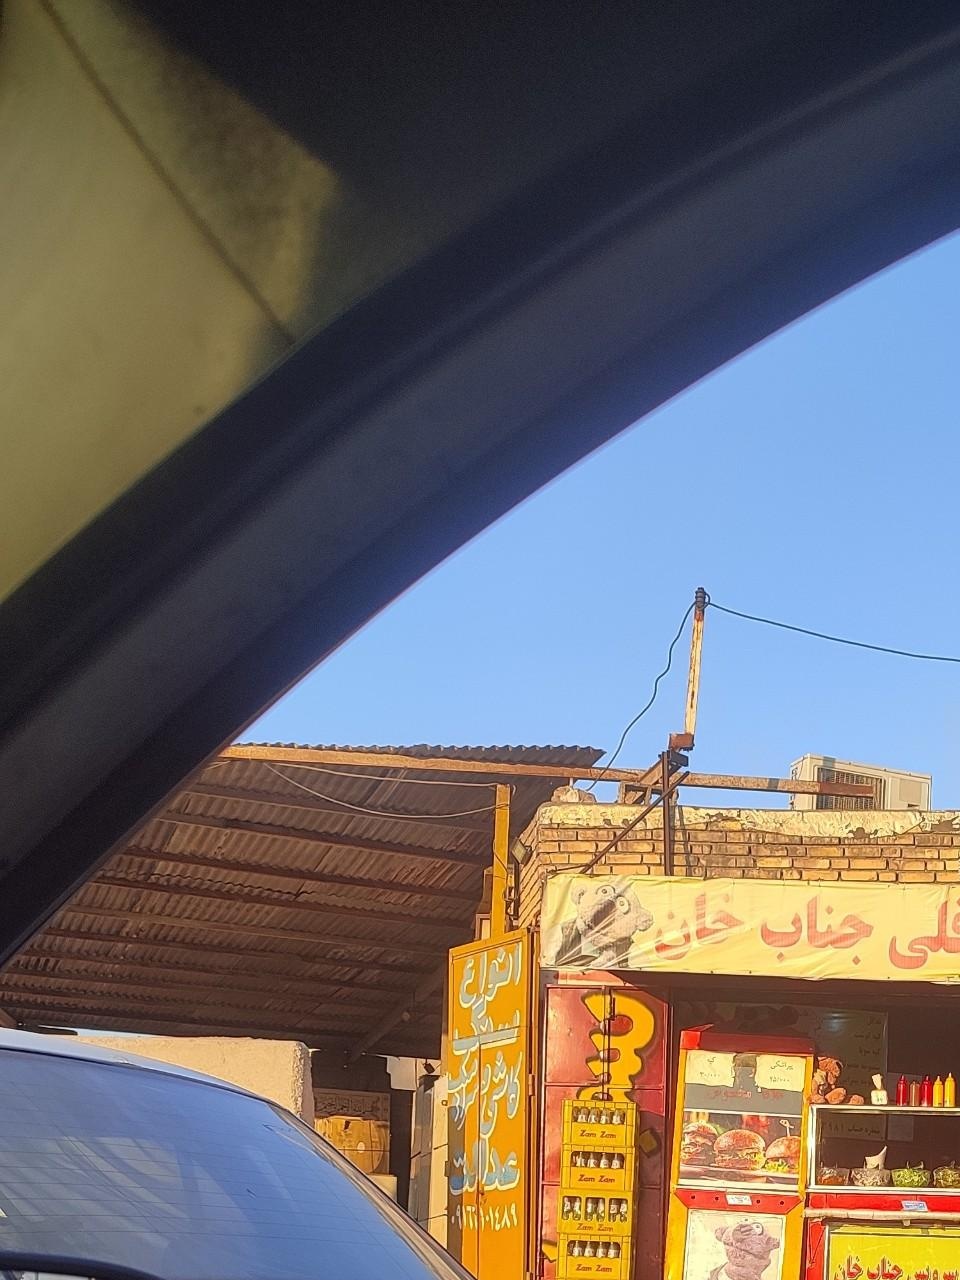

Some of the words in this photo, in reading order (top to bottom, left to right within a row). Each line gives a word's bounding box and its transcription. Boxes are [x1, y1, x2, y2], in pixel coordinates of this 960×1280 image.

[653, 893, 744, 961] خان
[760, 895, 875, 966] جناب
[580, 1129, 597, 1138] Zam
[600, 1131, 617, 1139] Zam
[577, 1174, 596, 1182] Zam
[598, 1175, 616, 1184] Zam
[575, 1263, 592, 1272] Zam
